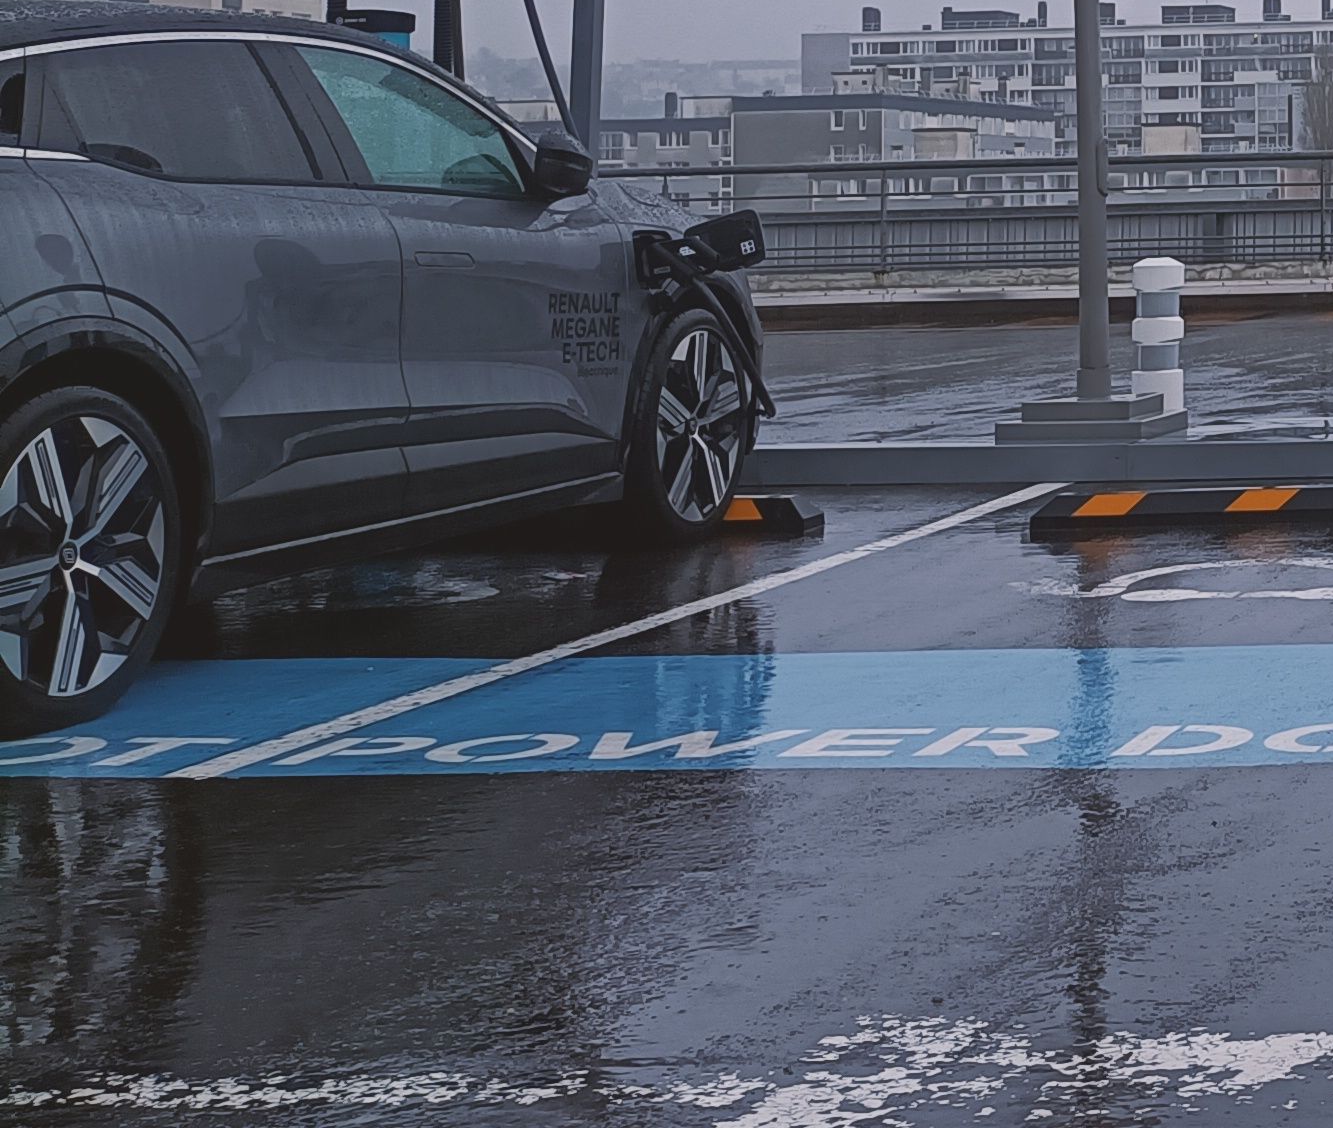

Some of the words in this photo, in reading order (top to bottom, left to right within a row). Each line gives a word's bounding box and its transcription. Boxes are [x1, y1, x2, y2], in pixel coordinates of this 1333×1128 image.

[548, 292, 620, 315] RENAULT
[551, 317, 620, 339] MEGANE
[562, 341, 620, 364] E-TECH
[0, 736, 240, 767] OT
[269, 726, 1061, 766] POWER
